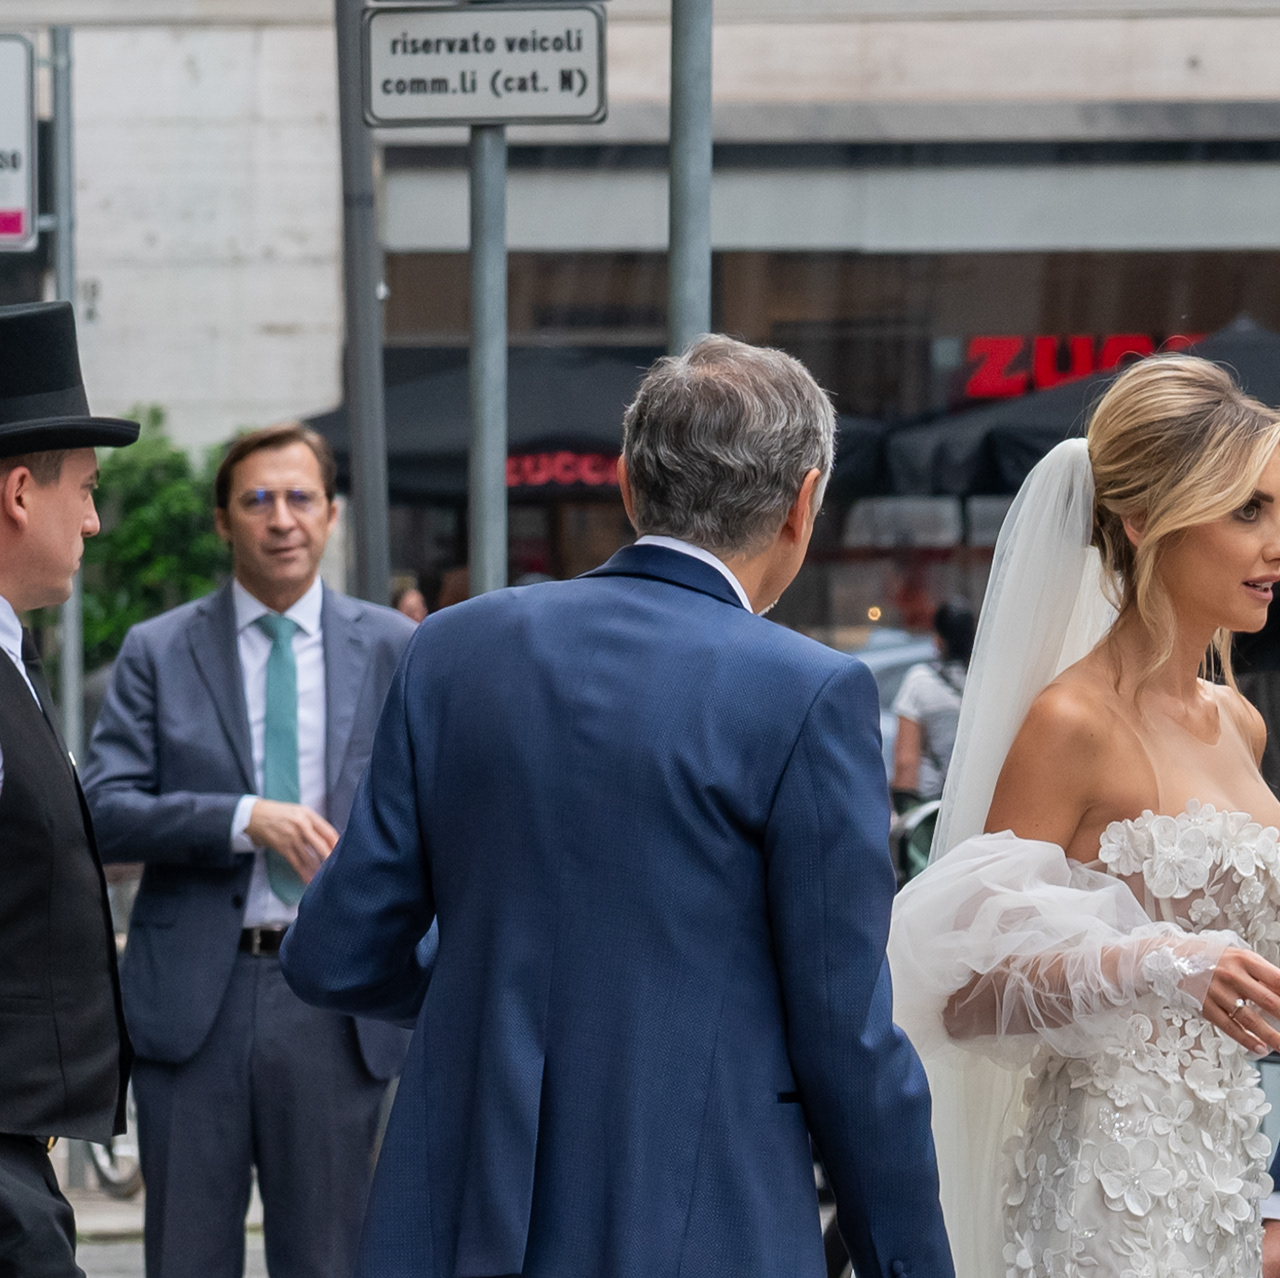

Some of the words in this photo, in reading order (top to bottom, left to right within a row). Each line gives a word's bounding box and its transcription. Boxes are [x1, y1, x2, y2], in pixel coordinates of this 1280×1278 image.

[390, 31, 496, 55] riservato
[505, 29, 583, 53] veicoli
[381, 70, 477, 95] comm.li
[489, 69, 549, 98] (cat.
[558, 68, 588, 98] N)
